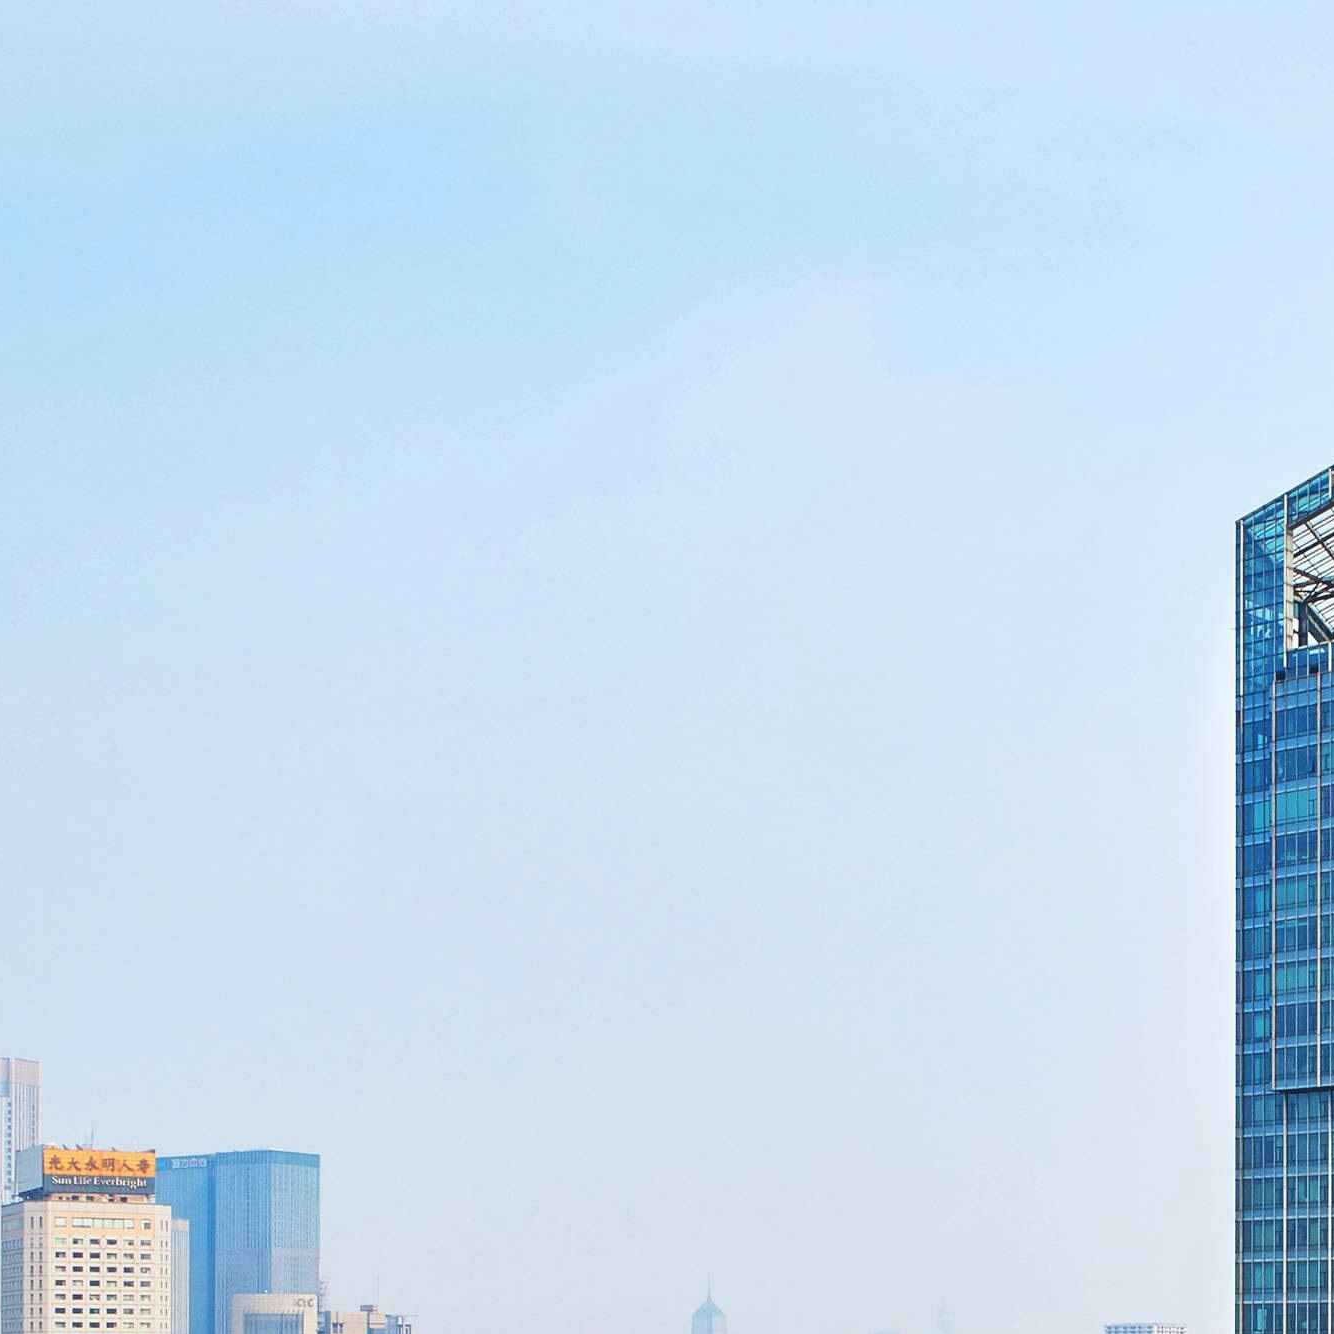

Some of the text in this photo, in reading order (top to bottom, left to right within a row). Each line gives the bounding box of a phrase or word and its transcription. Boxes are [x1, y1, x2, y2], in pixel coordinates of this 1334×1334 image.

[48, 1154, 150, 1174] 光大永明人寿
[51, 1176, 147, 1189] Sun Life Everbright
